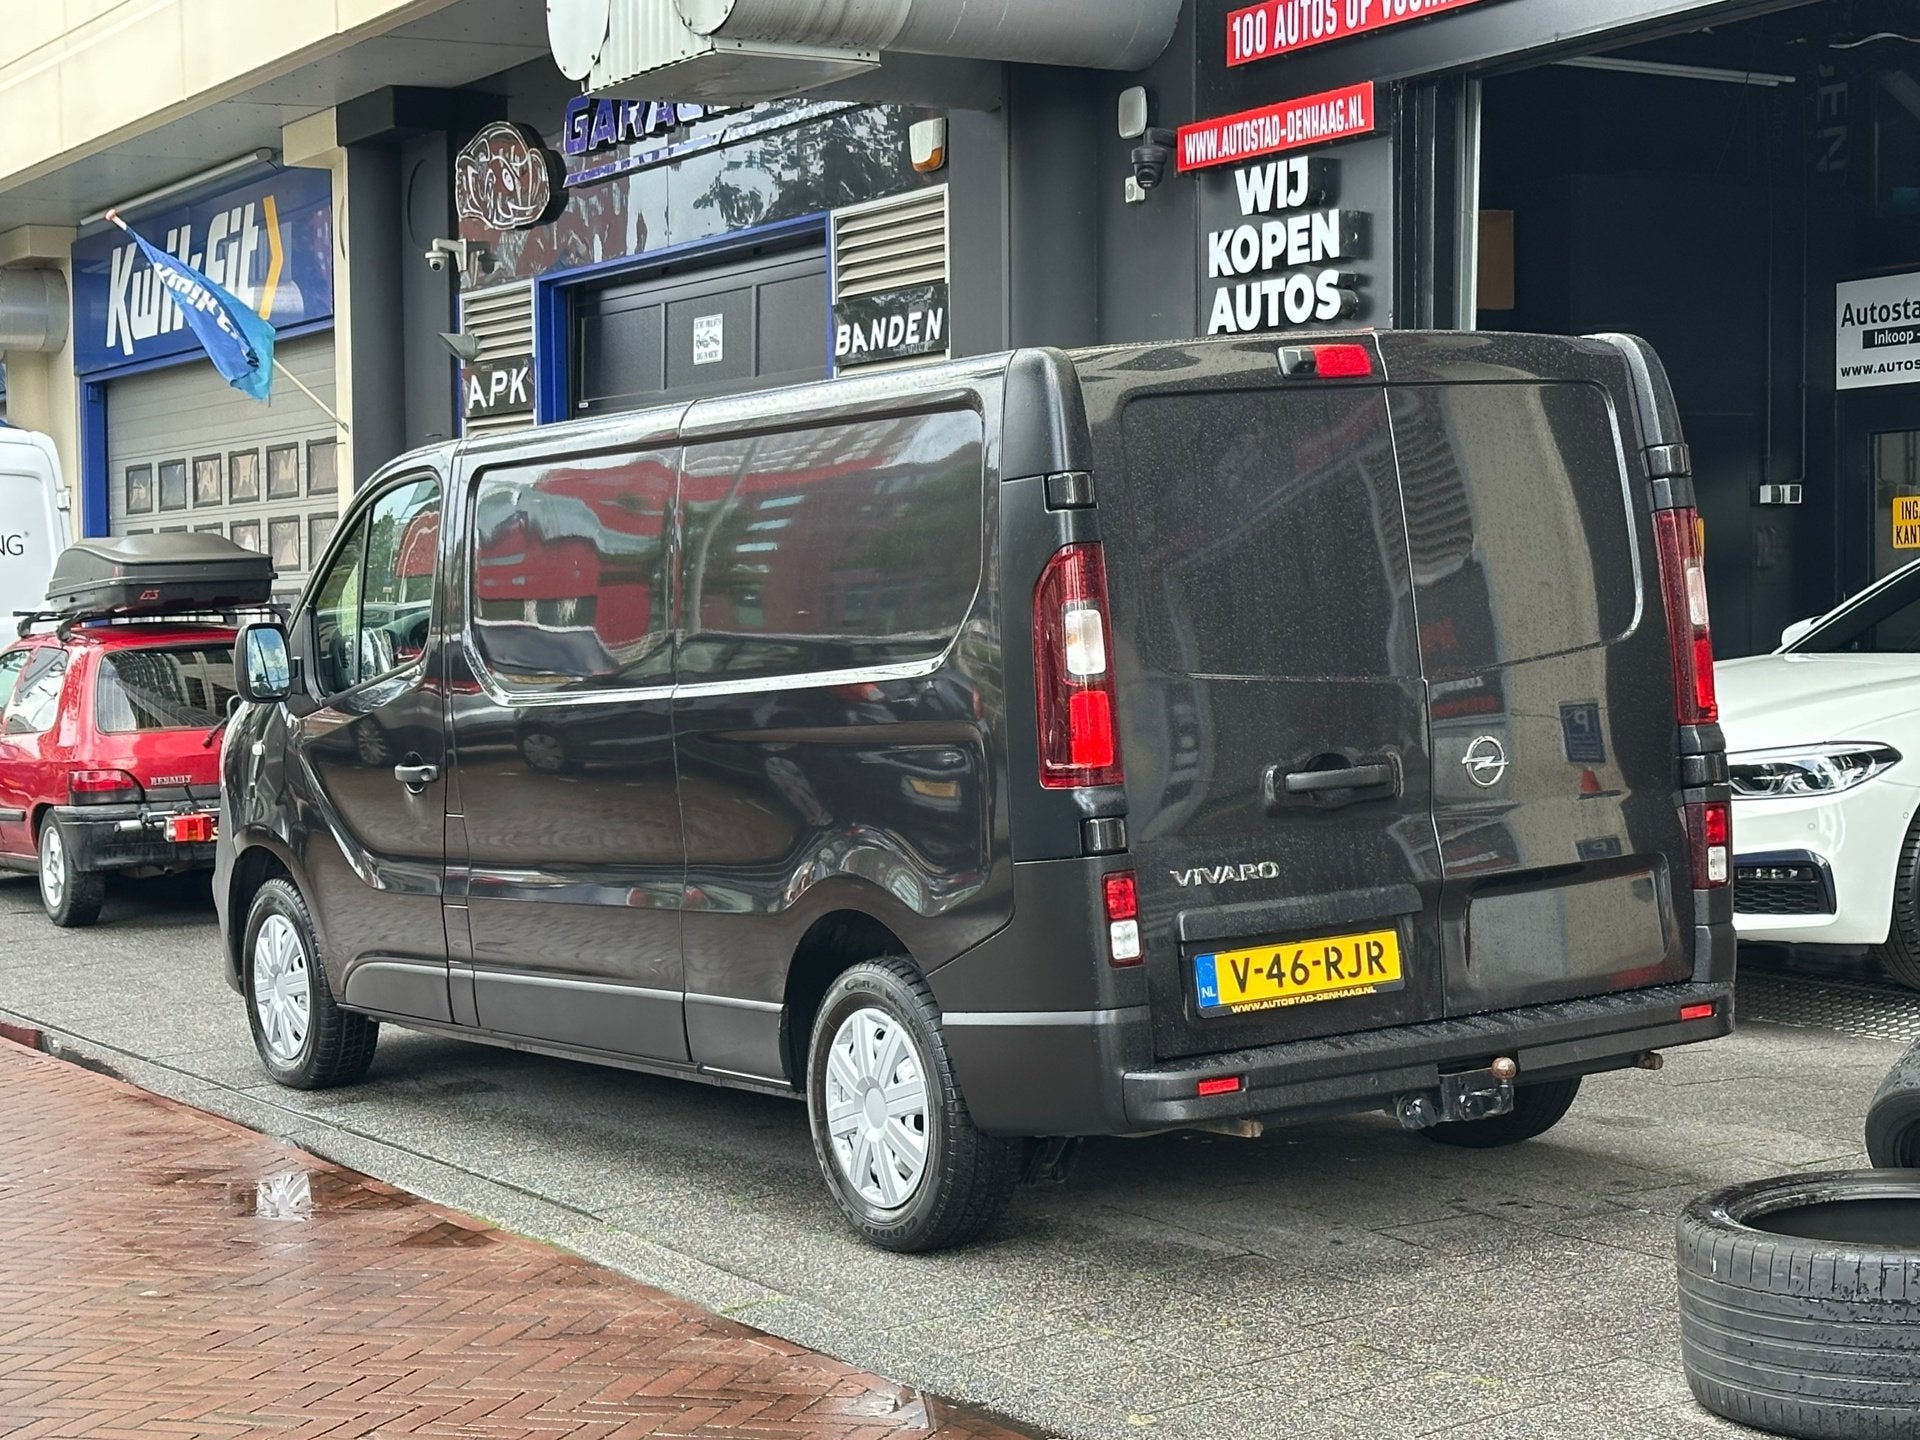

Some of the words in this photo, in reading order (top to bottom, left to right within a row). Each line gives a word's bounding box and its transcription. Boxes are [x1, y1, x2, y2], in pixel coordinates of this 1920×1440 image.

[1232, 9, 1267, 59] 100
[1273, 0, 1338, 49] AUTOS
[1184, 94, 1365, 165] WWW.AUTOSTAD-DENHAAG.NL
[1234, 155, 1309, 216] WIJ
[1208, 208, 1340, 278] KOPEN
[1207, 268, 1342, 335] AUTOS
[835, 307, 943, 356] BANDEN
[1874, 330, 1914, 345] Inkoop
[468, 366, 529, 410] APK
[1901, 500, 1920, 521] ING
[150, 774, 192, 786] RENAULT
[1169, 861, 1280, 887] VIVARO
[1230, 940, 1387, 994] V-46-RJR
[1201, 986, 1217, 999] NL
[1231, 985, 1377, 1014] WWW.AUTOSTAD-DENHAAG.NL
